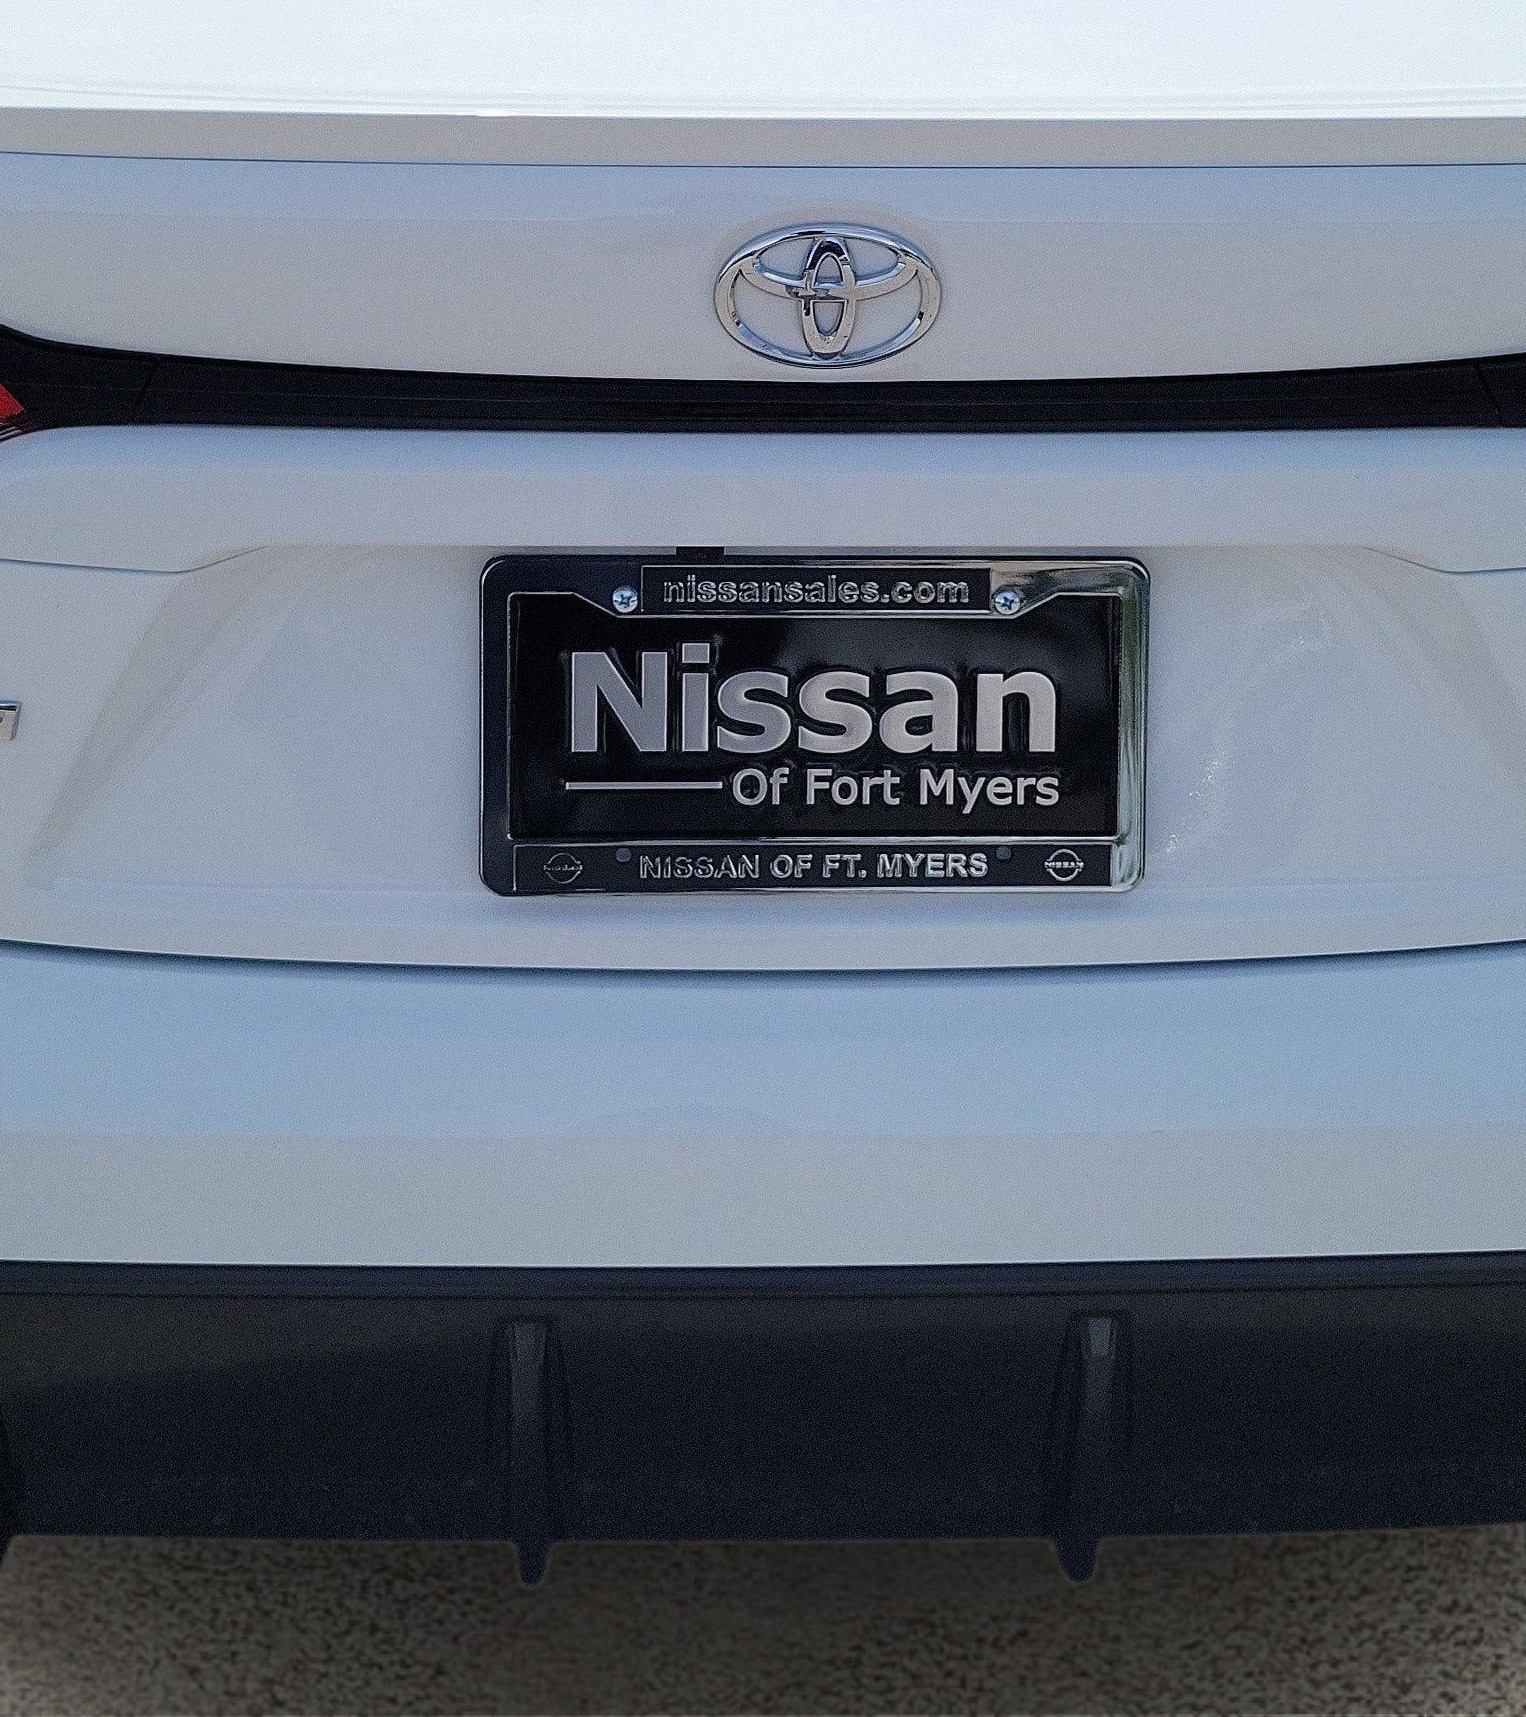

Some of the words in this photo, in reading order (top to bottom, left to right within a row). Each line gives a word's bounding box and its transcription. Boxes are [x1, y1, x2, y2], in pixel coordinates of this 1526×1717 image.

[663, 573, 970, 605] nissansales.com
[571, 642, 1056, 753] Nissan
[731, 766, 790, 806] Of
[805, 768, 900, 806] Fort
[919, 768, 1060, 815] Myers
[639, 854, 760, 879] NISSAN
[770, 854, 814, 879] OF
[823, 854, 868, 879] FT.
[876, 852, 988, 879] MYERS
